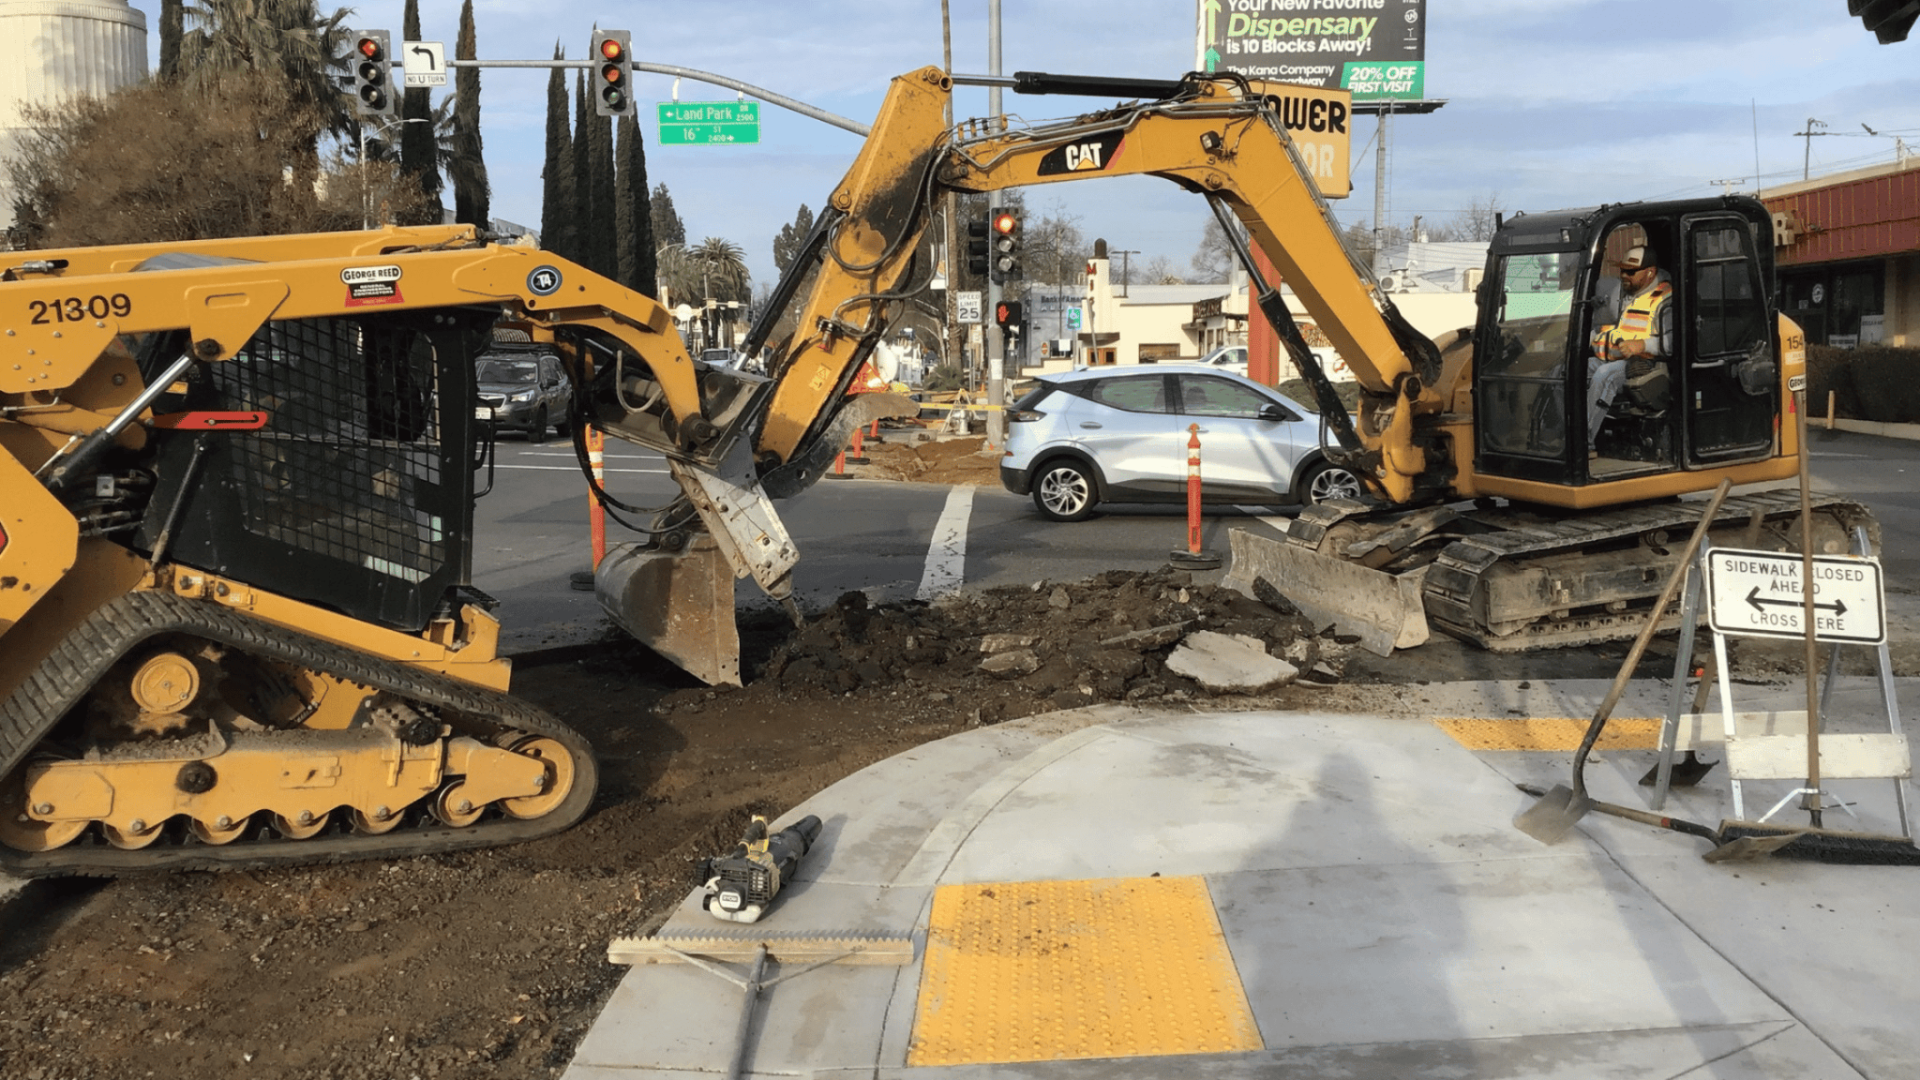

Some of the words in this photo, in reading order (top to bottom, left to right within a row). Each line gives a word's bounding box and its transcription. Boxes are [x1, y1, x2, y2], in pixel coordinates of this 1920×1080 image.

[1227, 0, 1268, 12] Your
[1271, 0, 1310, 11] New
[1313, 0, 1385, 10] Favorite
[1227, 11, 1378, 42] Dispensary
[1226, 38, 1240, 54] is
[1242, 39, 1260, 54] 10
[1262, 38, 1316, 53] Blocks
[1318, 37, 1371, 56] Away!
[1227, 65, 1248, 76] The
[1248, 65, 1278, 76] Kana
[1279, 64, 1335, 78] Company
[1349, 66, 1384, 81] 20%
[1386, 66, 1417, 80] OFF
[407, 75, 417, 83] NO
[418, 75, 426, 84] U
[427, 75, 445, 83] TURN
[1347, 81, 1381, 93] FIRST
[1382, 80, 1414, 92] VISIT
[675, 107, 703, 121] Land
[706, 106, 732, 120] Park
[1262, 94, 1346, 134] OWER
[1065, 142, 1102, 171] CAT
[343, 270, 376, 281] GEORGE
[378, 267, 400, 278] REED
[29, 293, 132, 325] 21309
[959, 307, 979, 319] 25
[1725, 559, 1798, 578] SIDEWALK
[1812, 567, 1865, 582] LOSED
[1816, 616, 1845, 631] ERE
